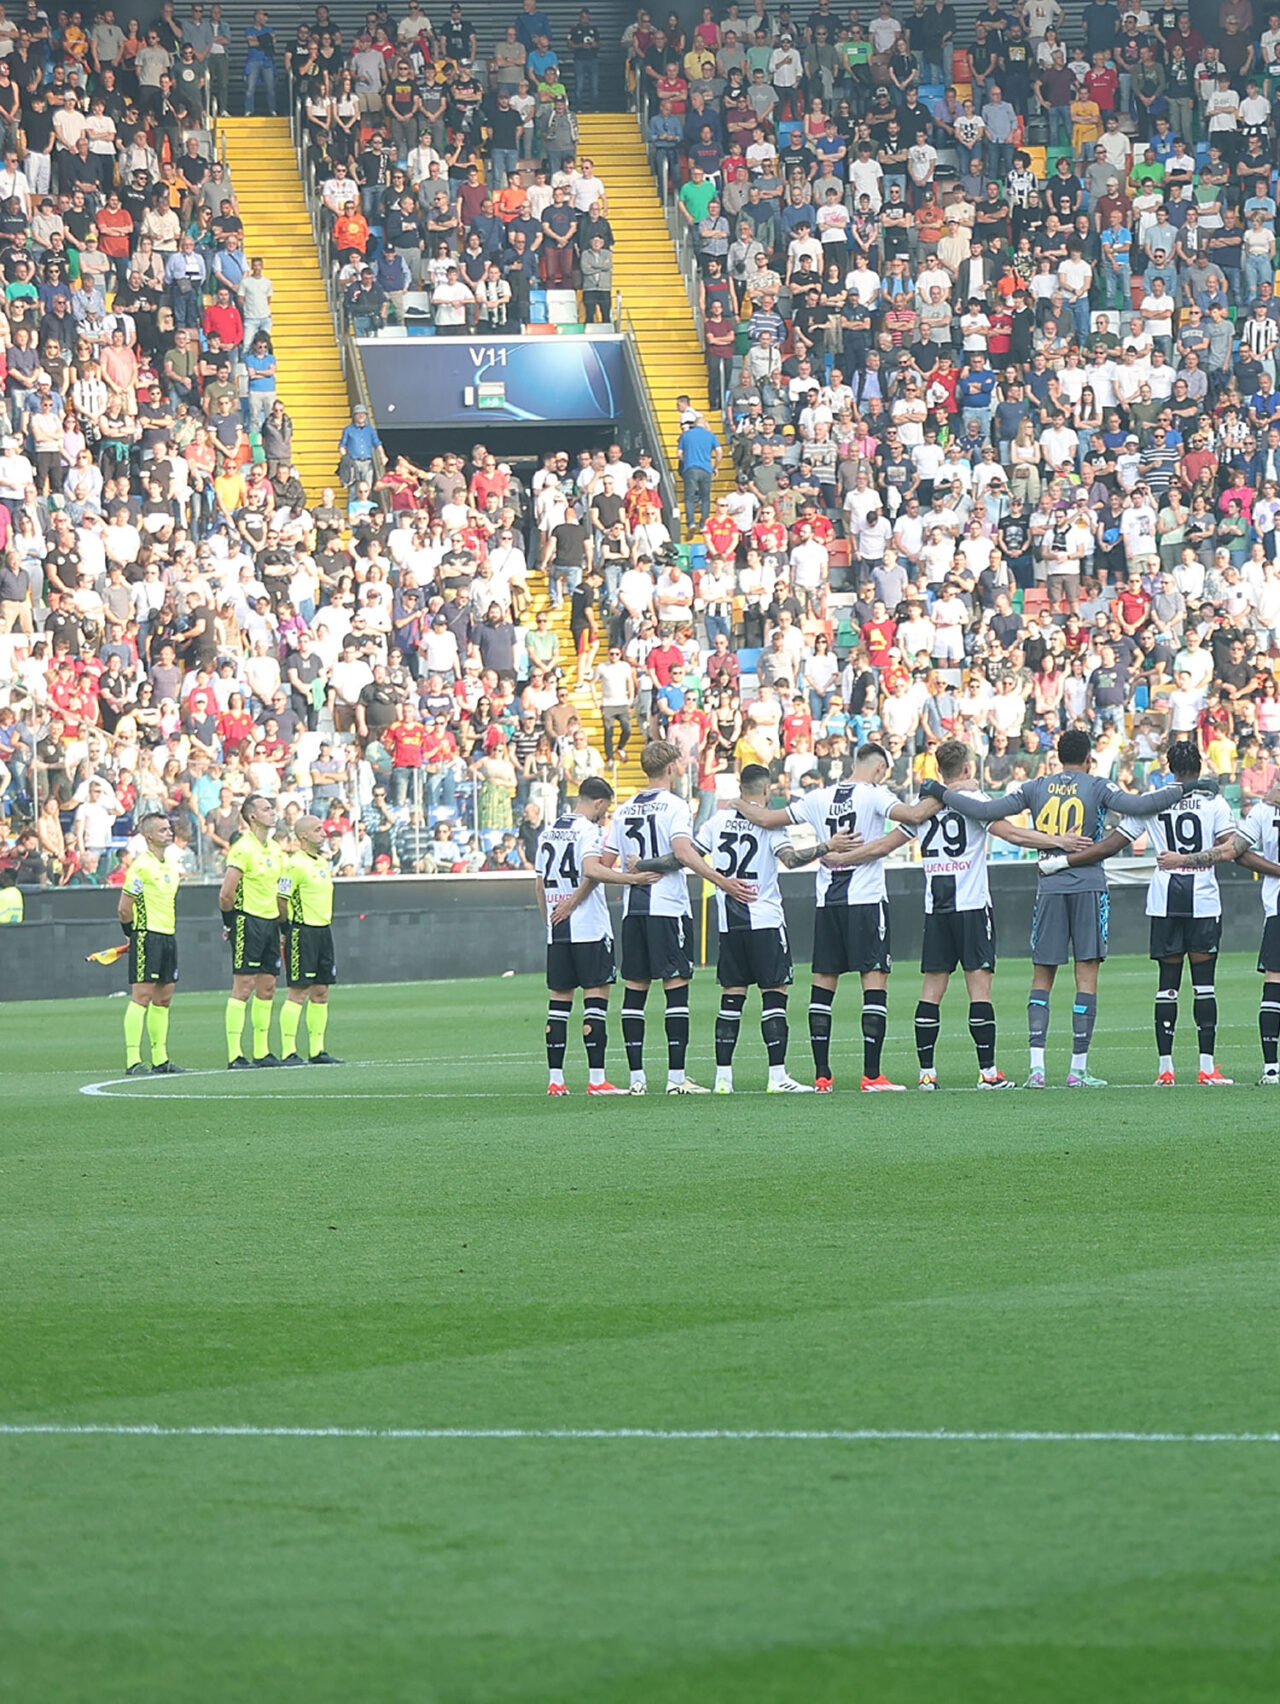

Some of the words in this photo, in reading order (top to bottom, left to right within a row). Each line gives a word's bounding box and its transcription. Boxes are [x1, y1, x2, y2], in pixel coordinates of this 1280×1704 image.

[469, 347, 507, 367] V11
[624, 814, 660, 858] 31
[921, 812, 967, 858] 29
[1035, 796, 1084, 836] 40
[1158, 812, 1203, 855] 19
[541, 842, 580, 889] 24
[715, 831, 758, 880] 32
